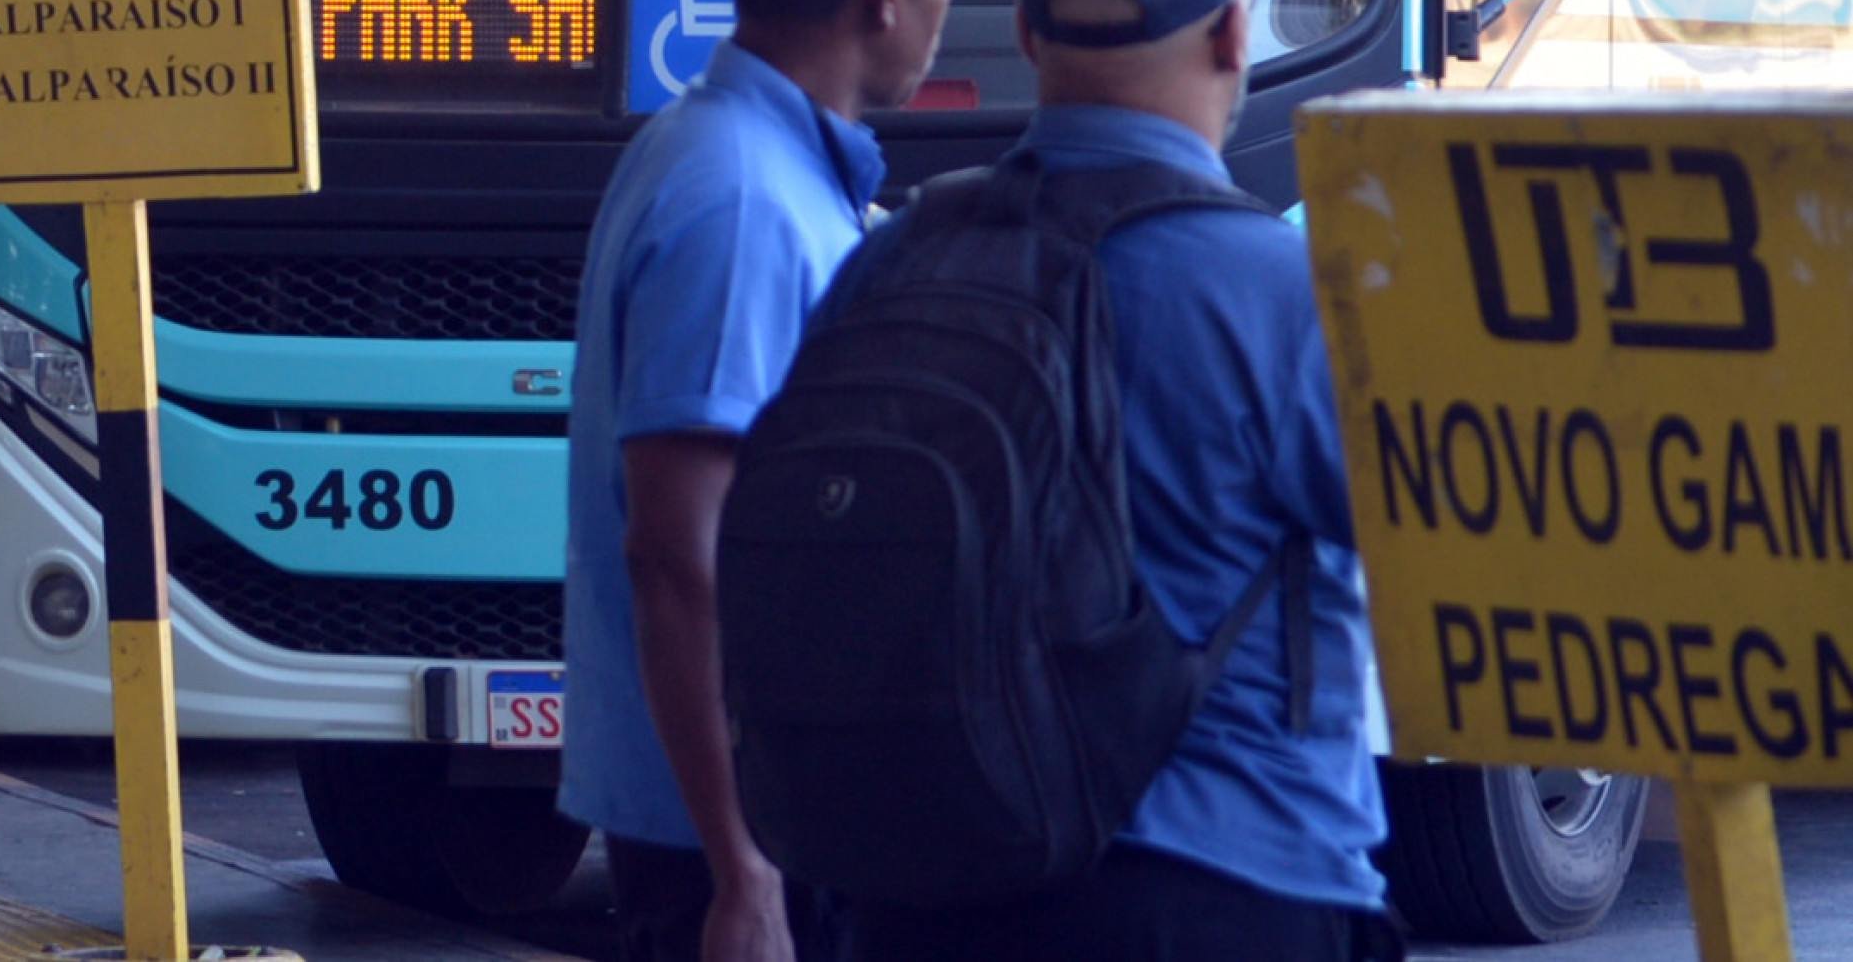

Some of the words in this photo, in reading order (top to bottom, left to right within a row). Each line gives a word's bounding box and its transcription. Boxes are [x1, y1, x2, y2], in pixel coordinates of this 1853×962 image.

[247, 61, 276, 94] II
[1447, 142, 1776, 353] UTB
[254, 468, 455, 531] 3480
[1373, 398, 1622, 545] NOVO
